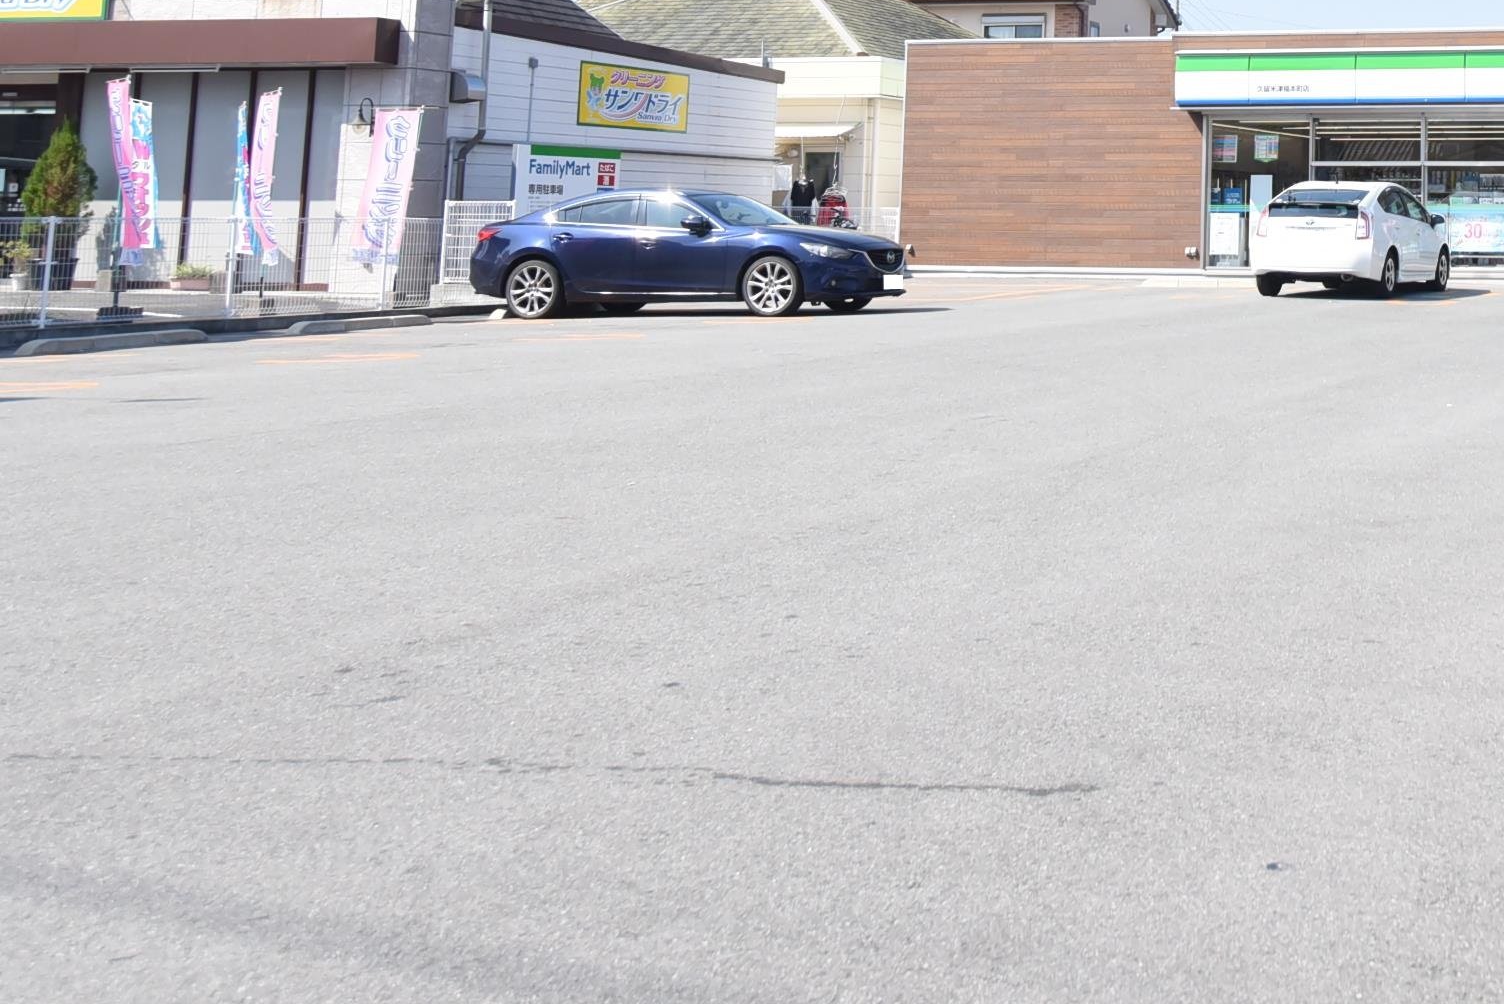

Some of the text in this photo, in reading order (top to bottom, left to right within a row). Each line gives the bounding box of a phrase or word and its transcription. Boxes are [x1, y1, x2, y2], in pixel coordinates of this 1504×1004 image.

[611, 71, 665, 89] クリーニング
[605, 89, 682, 115] サンワドライ
[529, 159, 591, 178] FamilyMart
[600, 163, 615, 172] たばこ
[528, 184, 563, 196] 専用駐車場
[1464, 223, 1483, 238] 30
